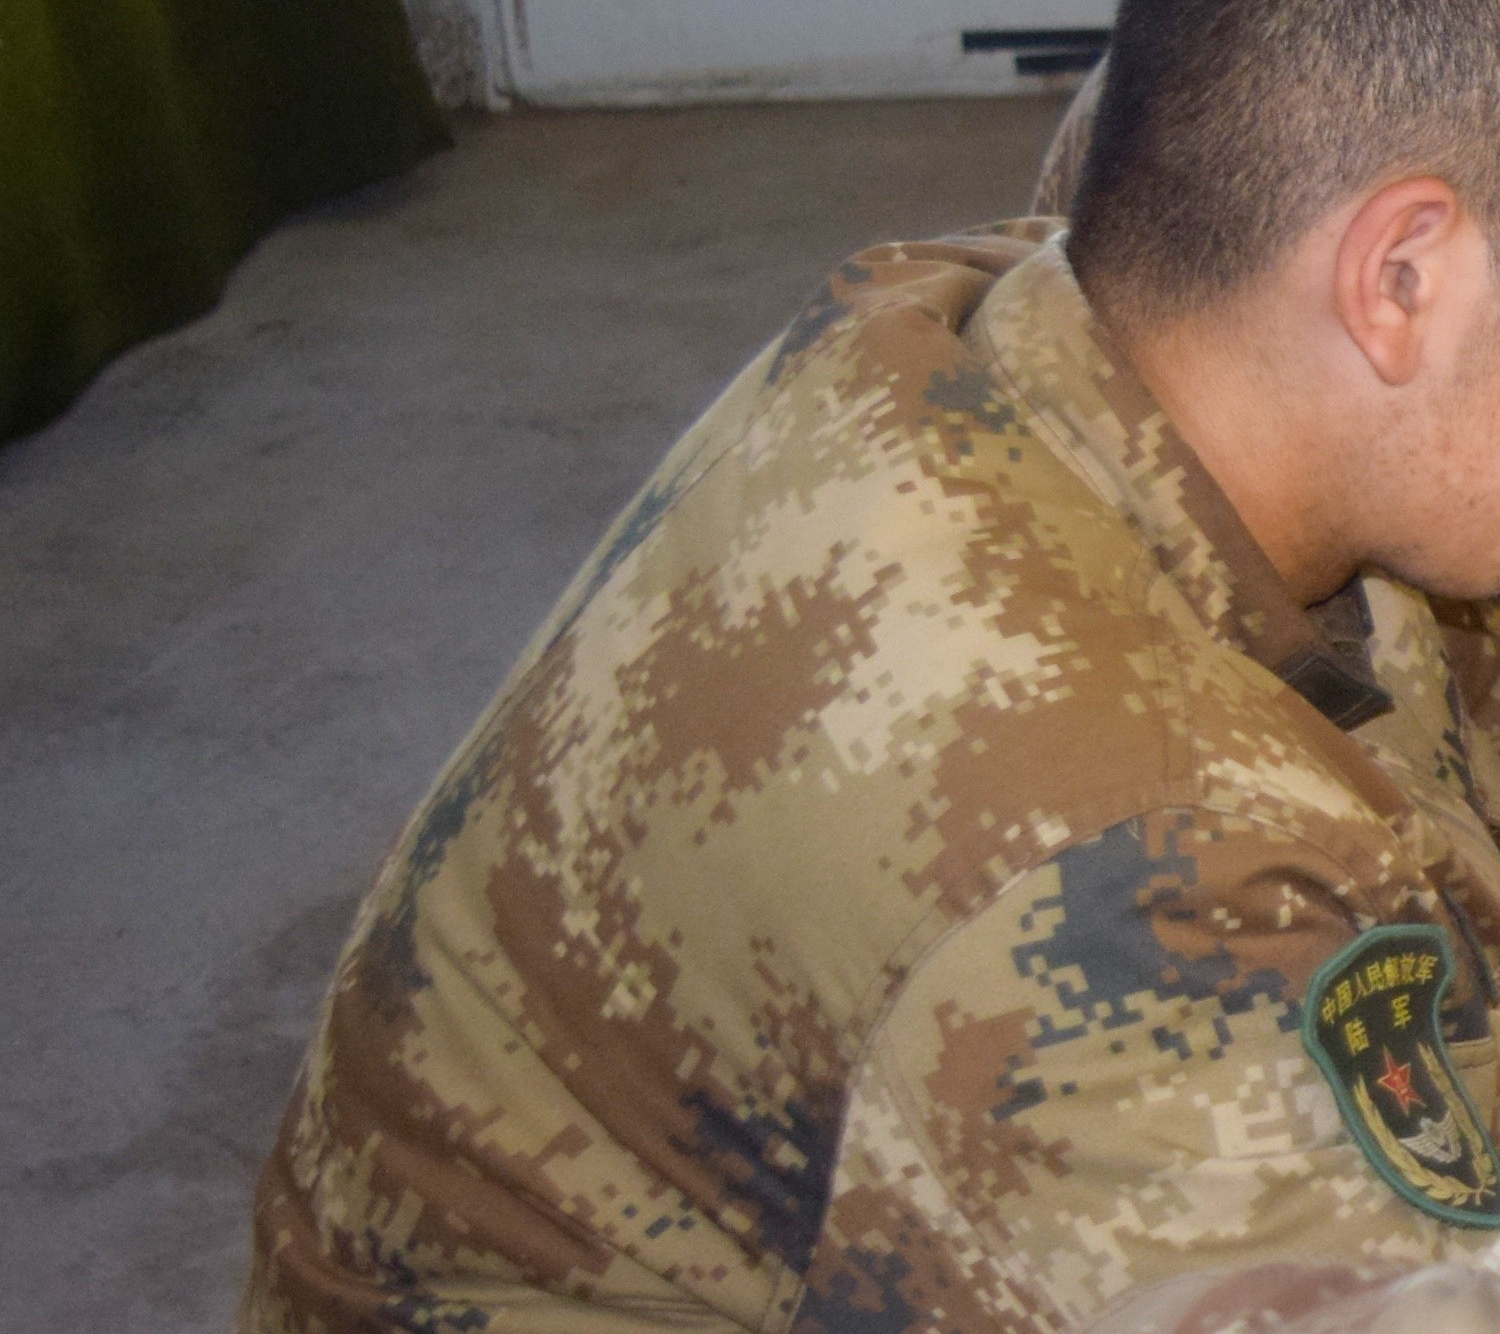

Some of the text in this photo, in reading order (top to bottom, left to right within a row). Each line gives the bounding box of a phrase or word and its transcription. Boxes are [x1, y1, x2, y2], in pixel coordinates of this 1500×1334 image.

[1319, 952, 1439, 1025] 中国人民解放军
[1342, 994, 1413, 1057] 陆军
